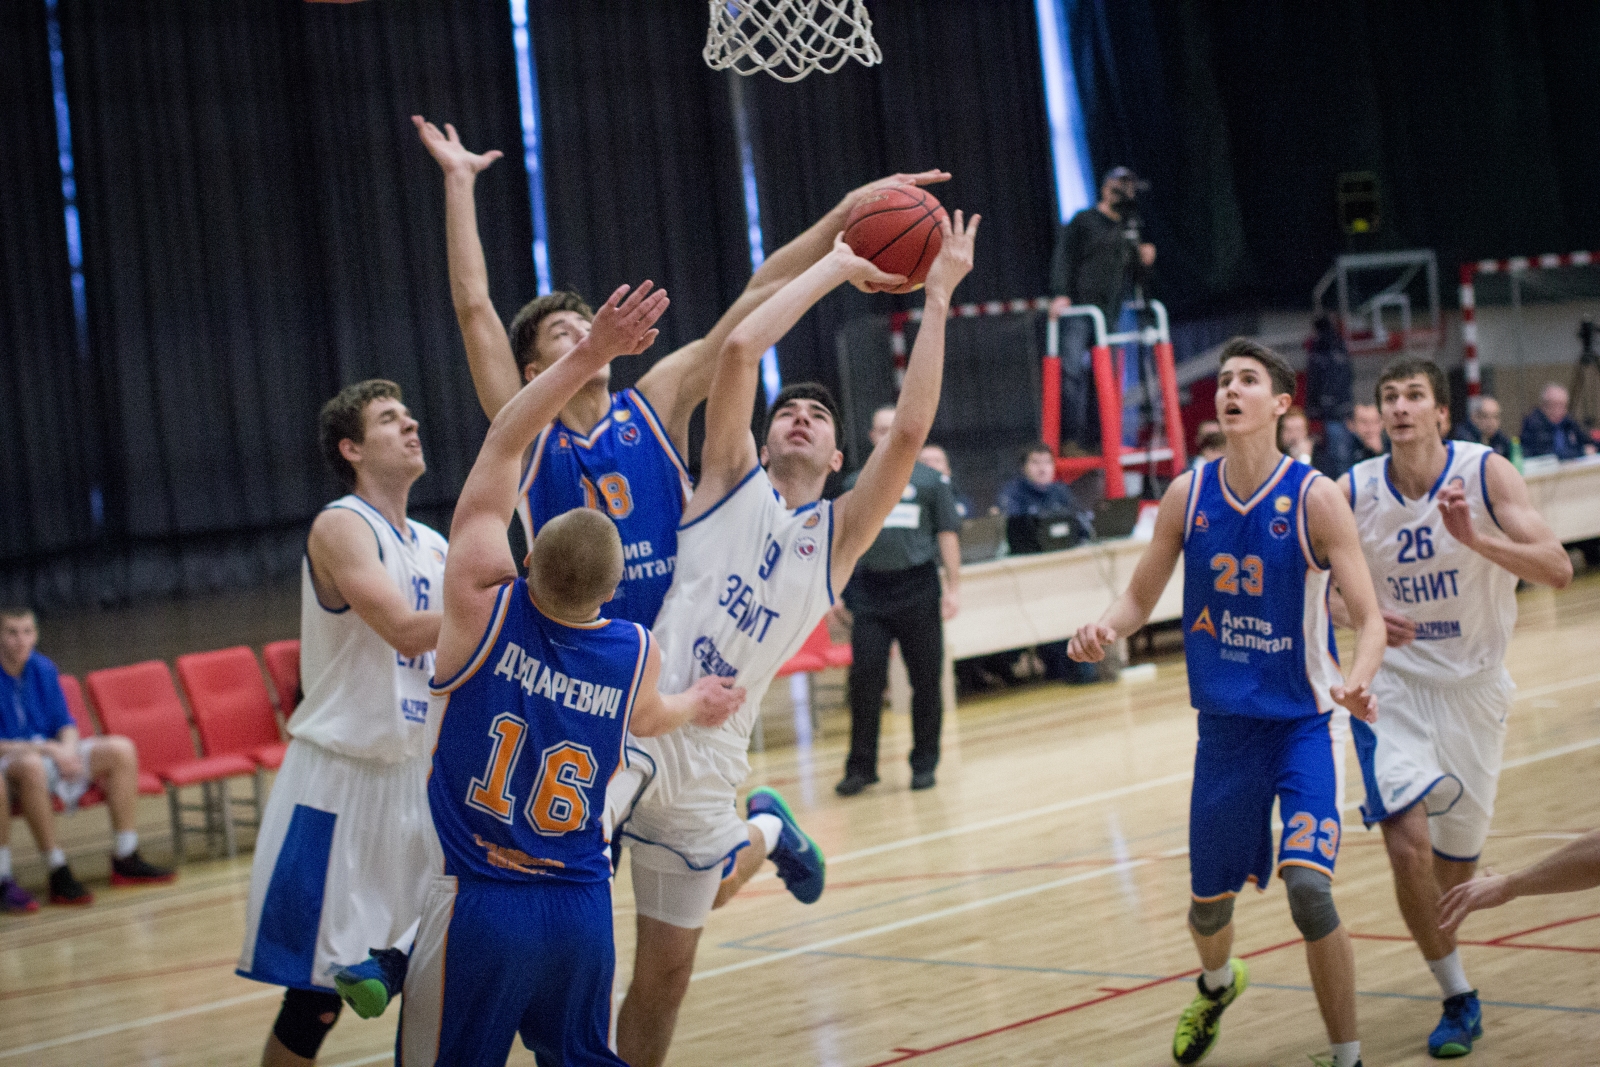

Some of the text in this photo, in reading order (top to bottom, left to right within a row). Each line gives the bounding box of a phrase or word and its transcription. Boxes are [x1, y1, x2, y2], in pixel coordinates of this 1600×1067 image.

[1397, 525, 1435, 564] 26
[1210, 553, 1263, 597] 23
[1387, 569, 1459, 603] ЗЕНИТ
[1221, 609, 1273, 636] Актив
[1221, 627, 1293, 654] Капитал
[493, 641, 623, 719] ДУДАРЕВИЧ
[465, 711, 599, 837] 16
[1284, 811, 1339, 861] 23
